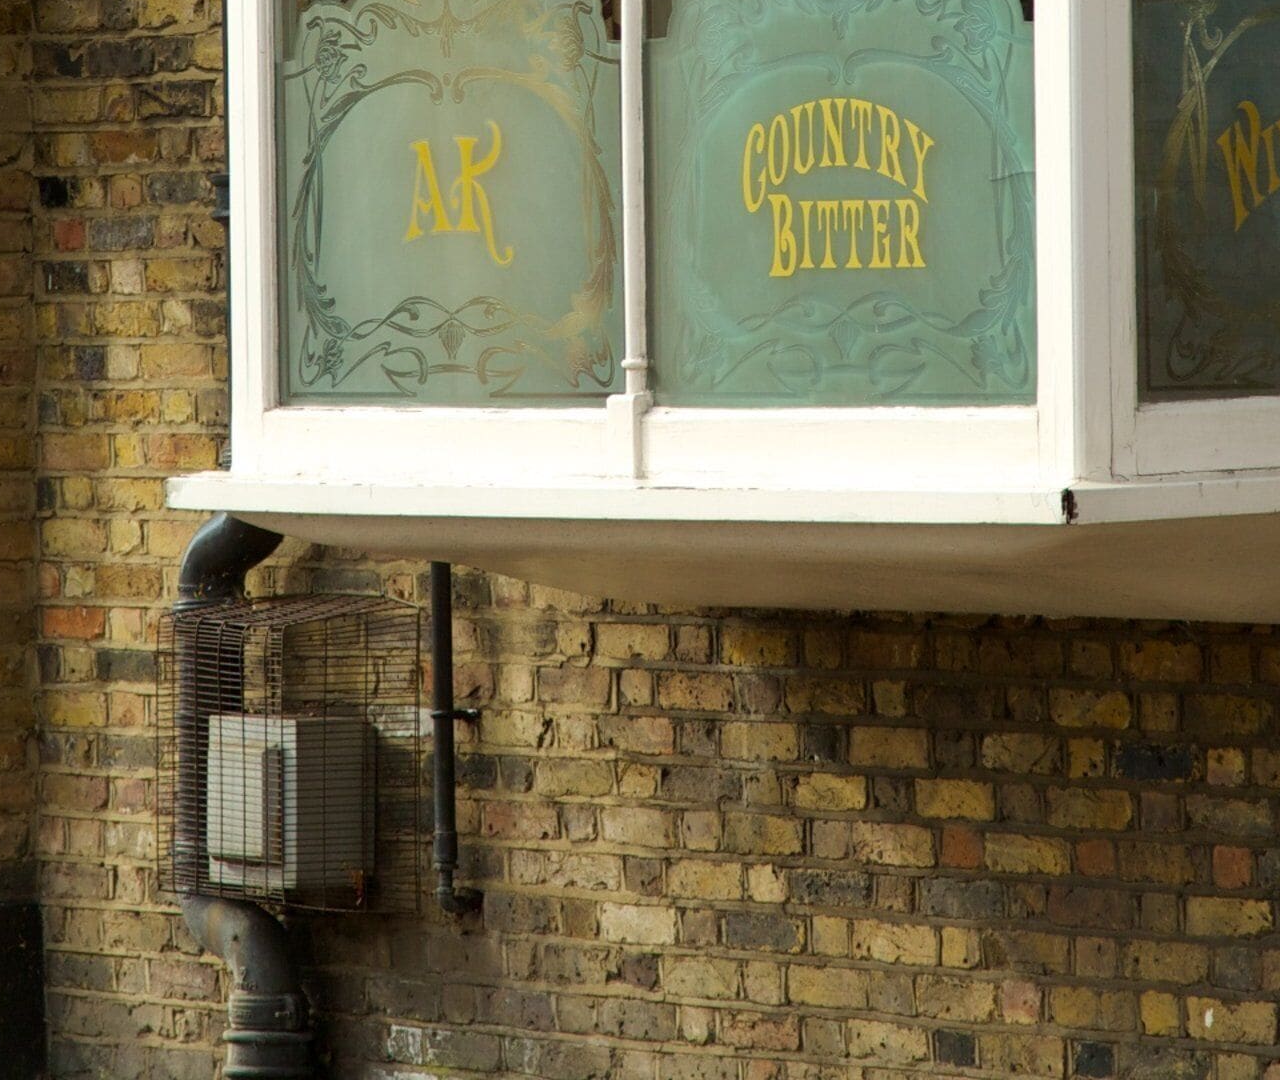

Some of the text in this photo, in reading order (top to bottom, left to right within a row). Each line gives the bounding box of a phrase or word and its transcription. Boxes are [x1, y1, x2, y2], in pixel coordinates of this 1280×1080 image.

[404, 120, 515, 267] AK
[742, 97, 935, 214] COUNTRY
[768, 193, 927, 278] BITTER
